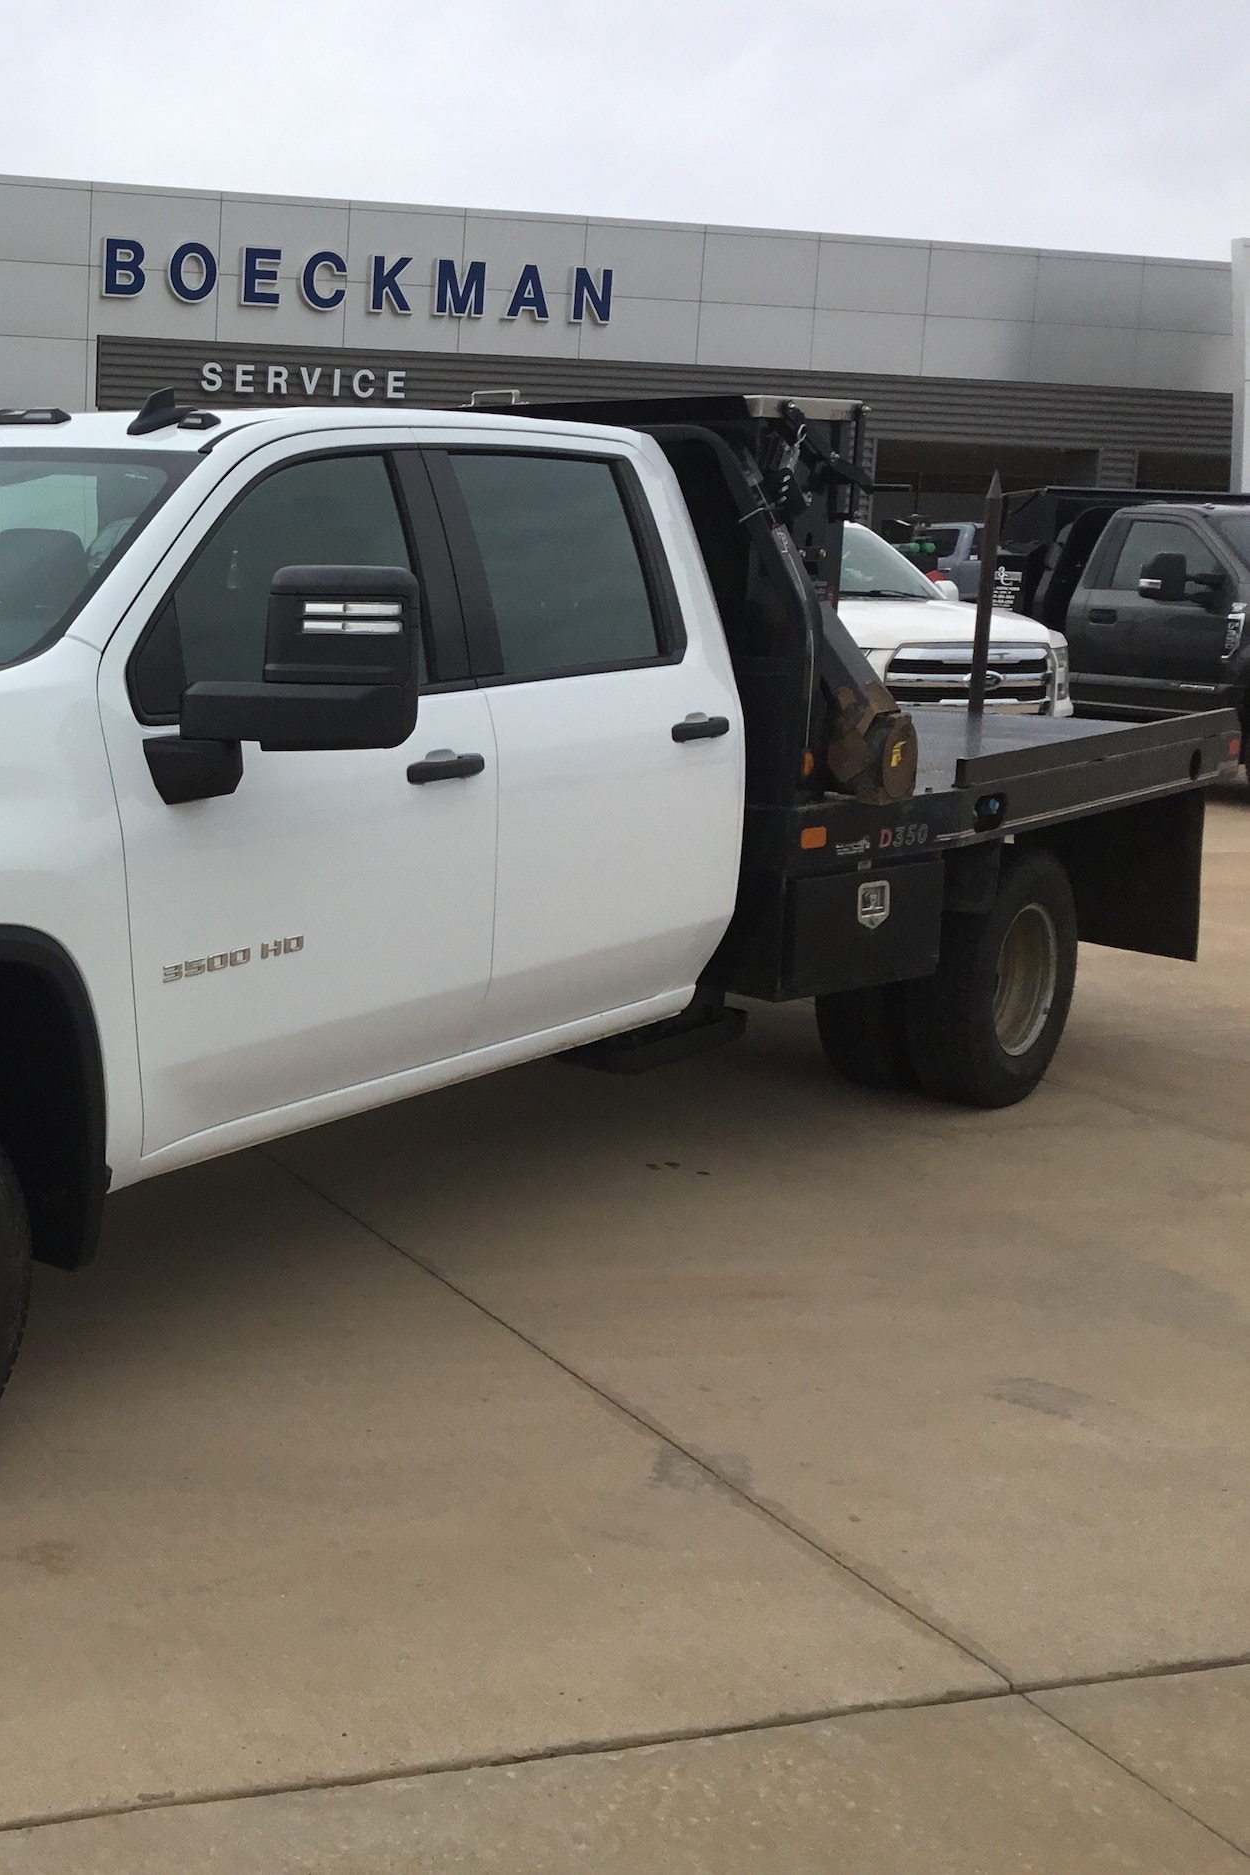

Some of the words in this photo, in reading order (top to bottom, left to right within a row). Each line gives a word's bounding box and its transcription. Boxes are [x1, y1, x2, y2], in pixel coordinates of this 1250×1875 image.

[102, 236, 614, 325] BOECKMAN
[201, 362, 407, 399] SERVICE
[162, 946, 251, 984] 3500
[260, 934, 305, 960] HD
